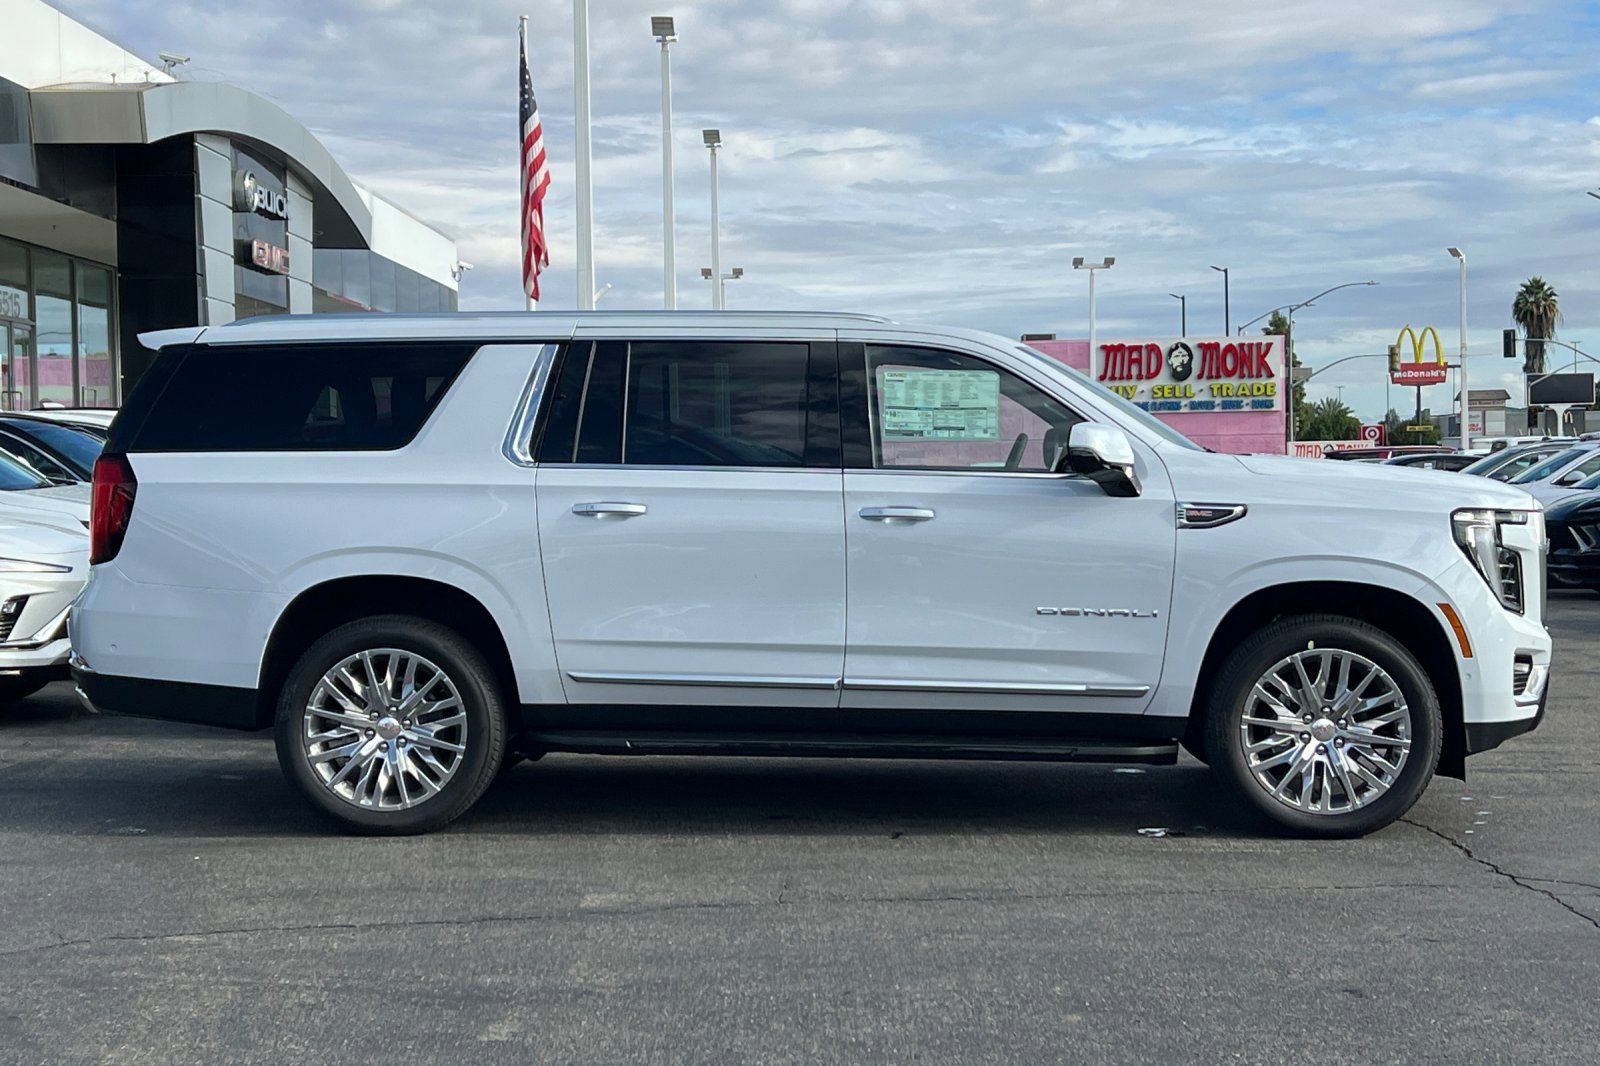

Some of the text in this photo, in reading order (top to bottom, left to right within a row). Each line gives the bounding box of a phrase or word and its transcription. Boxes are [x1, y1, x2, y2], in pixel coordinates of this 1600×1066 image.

[1098, 342, 1276, 381] MAD MONK
[1152, 384, 1195, 398] SELL
[1210, 382, 1277, 397] TRADE
[1295, 444, 1322, 458] MAD
[1036, 606, 1158, 618] DENALI
